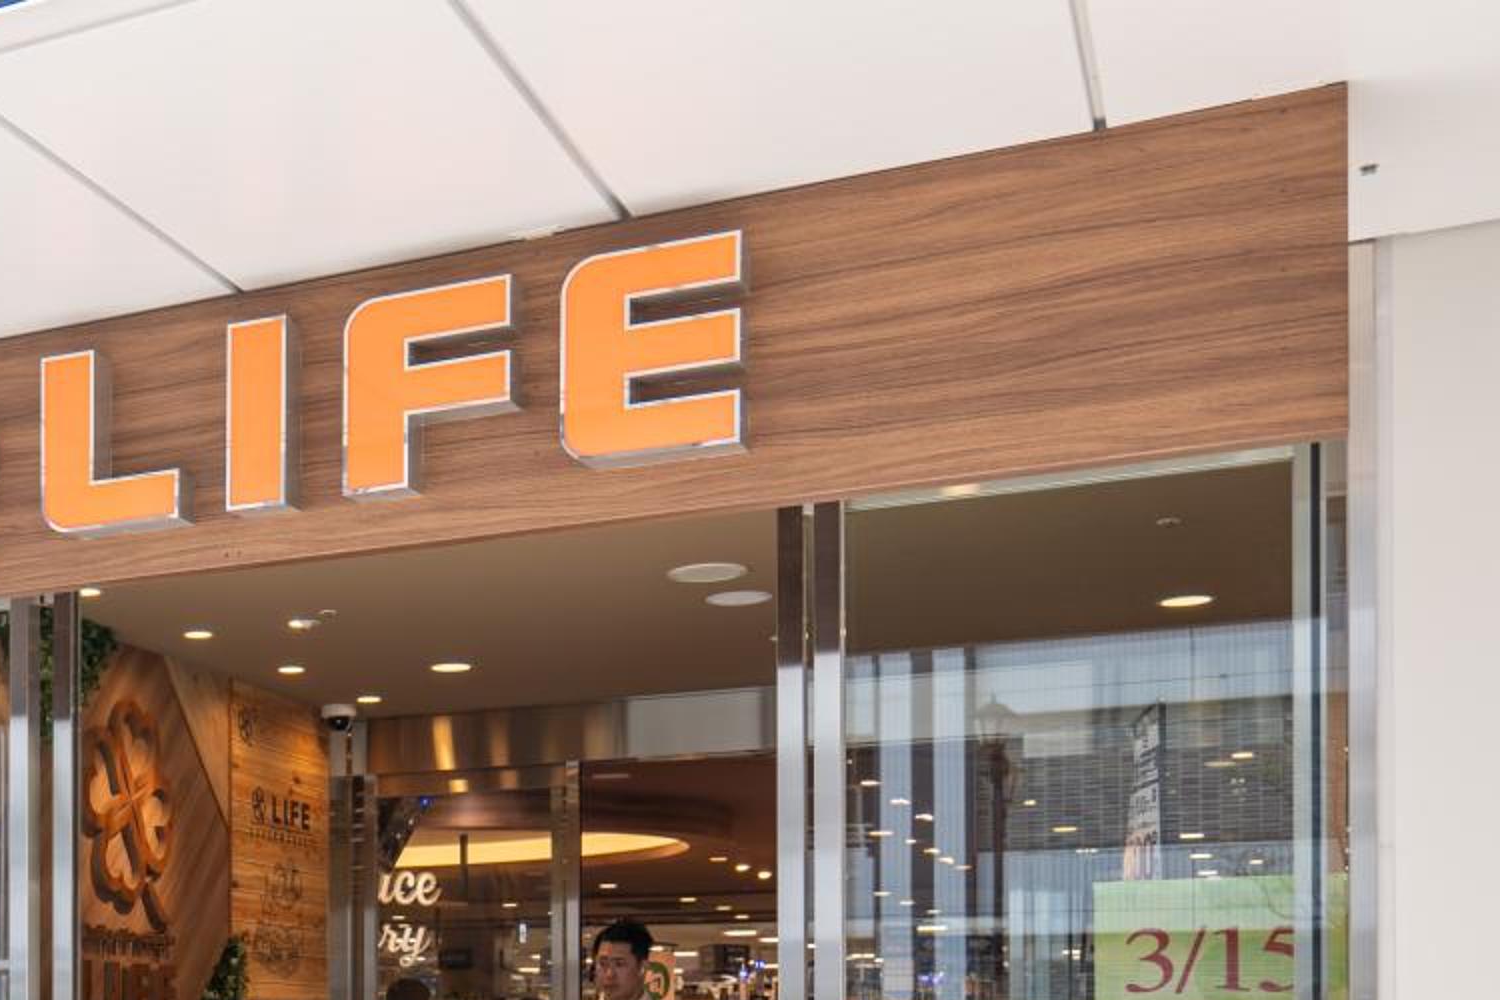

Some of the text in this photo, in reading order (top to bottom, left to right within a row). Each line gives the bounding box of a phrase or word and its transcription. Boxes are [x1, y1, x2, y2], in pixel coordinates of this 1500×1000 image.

[40, 230, 742, 533] LIFE
[270, 795, 312, 831] LIFE
[1125, 925, 1295, 994] 3/15
